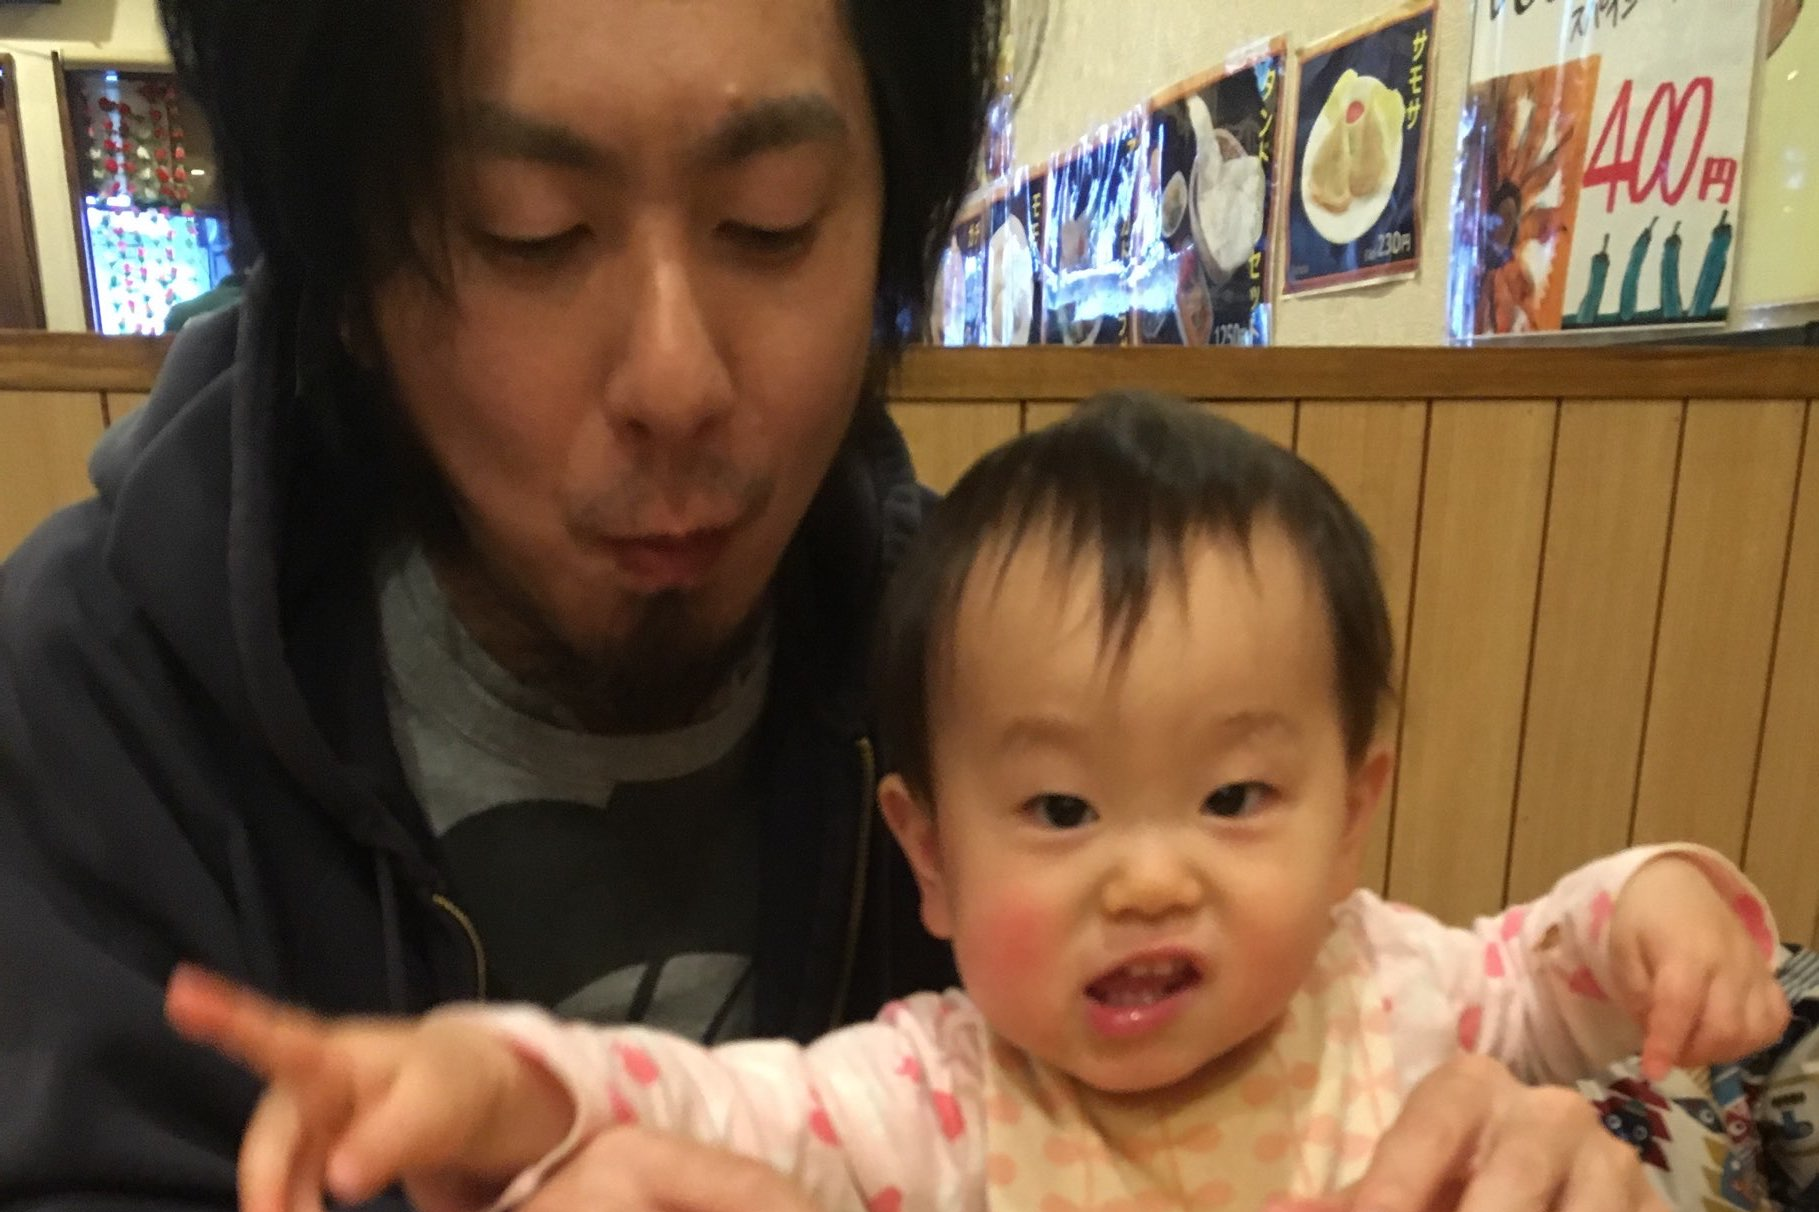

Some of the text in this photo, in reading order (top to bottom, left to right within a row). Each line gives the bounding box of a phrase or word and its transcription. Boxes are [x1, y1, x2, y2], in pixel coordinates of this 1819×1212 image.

[1406, 28, 1428, 129] サモサ
[1582, 76, 1738, 213] 400円
